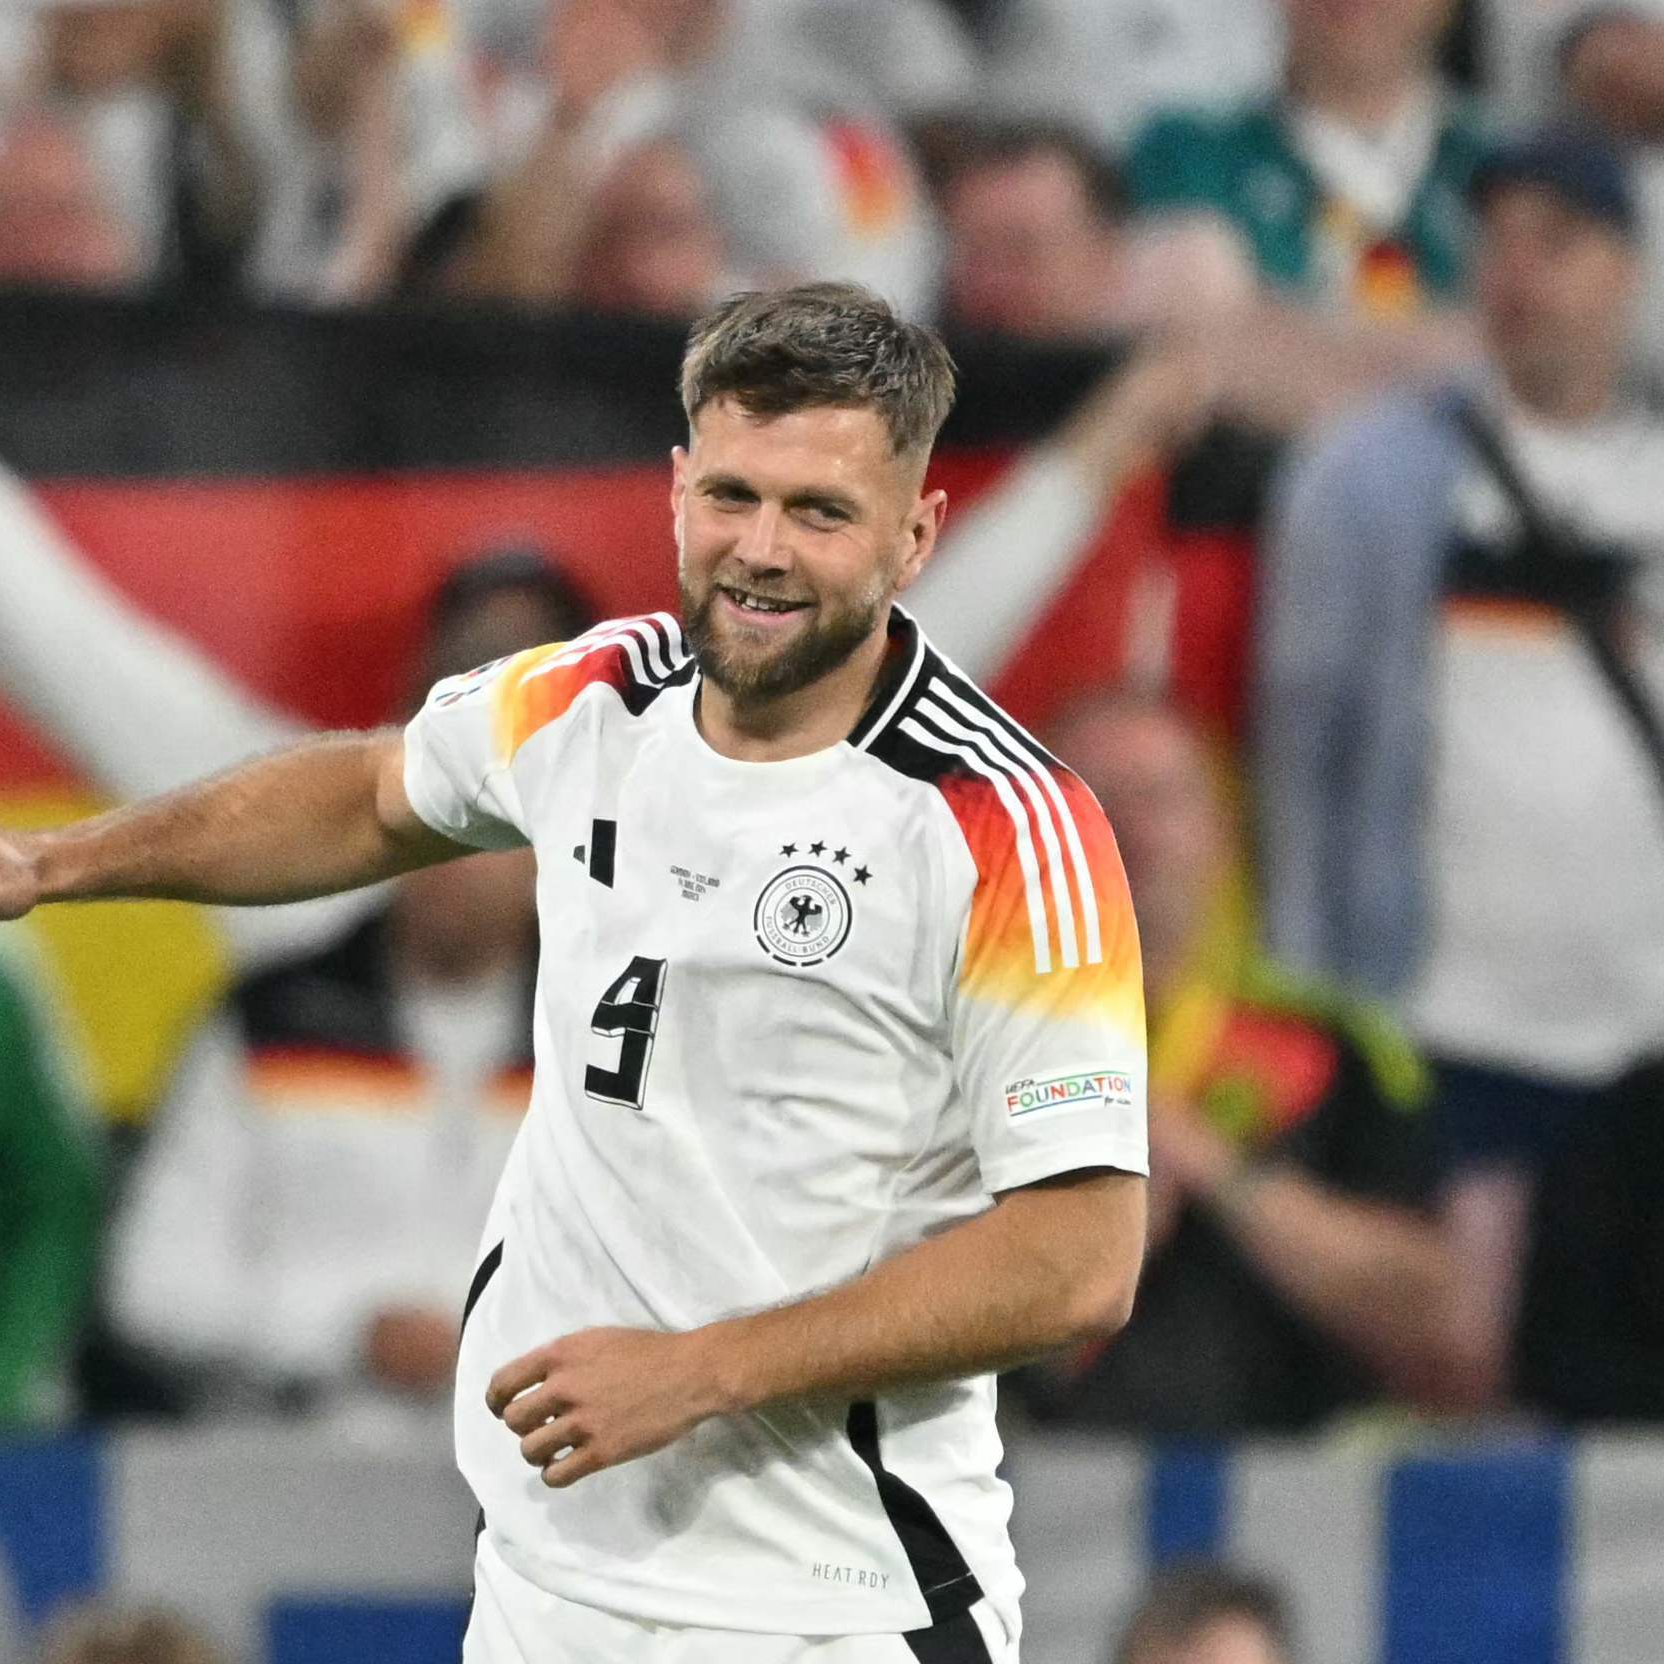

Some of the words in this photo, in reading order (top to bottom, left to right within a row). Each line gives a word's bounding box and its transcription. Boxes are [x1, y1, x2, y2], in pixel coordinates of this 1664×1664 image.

[584, 955, 668, 1111] 9
[1005, 1078, 1035, 1094] UEFA
[1007, 1076, 1132, 1112] FOUNDATION
